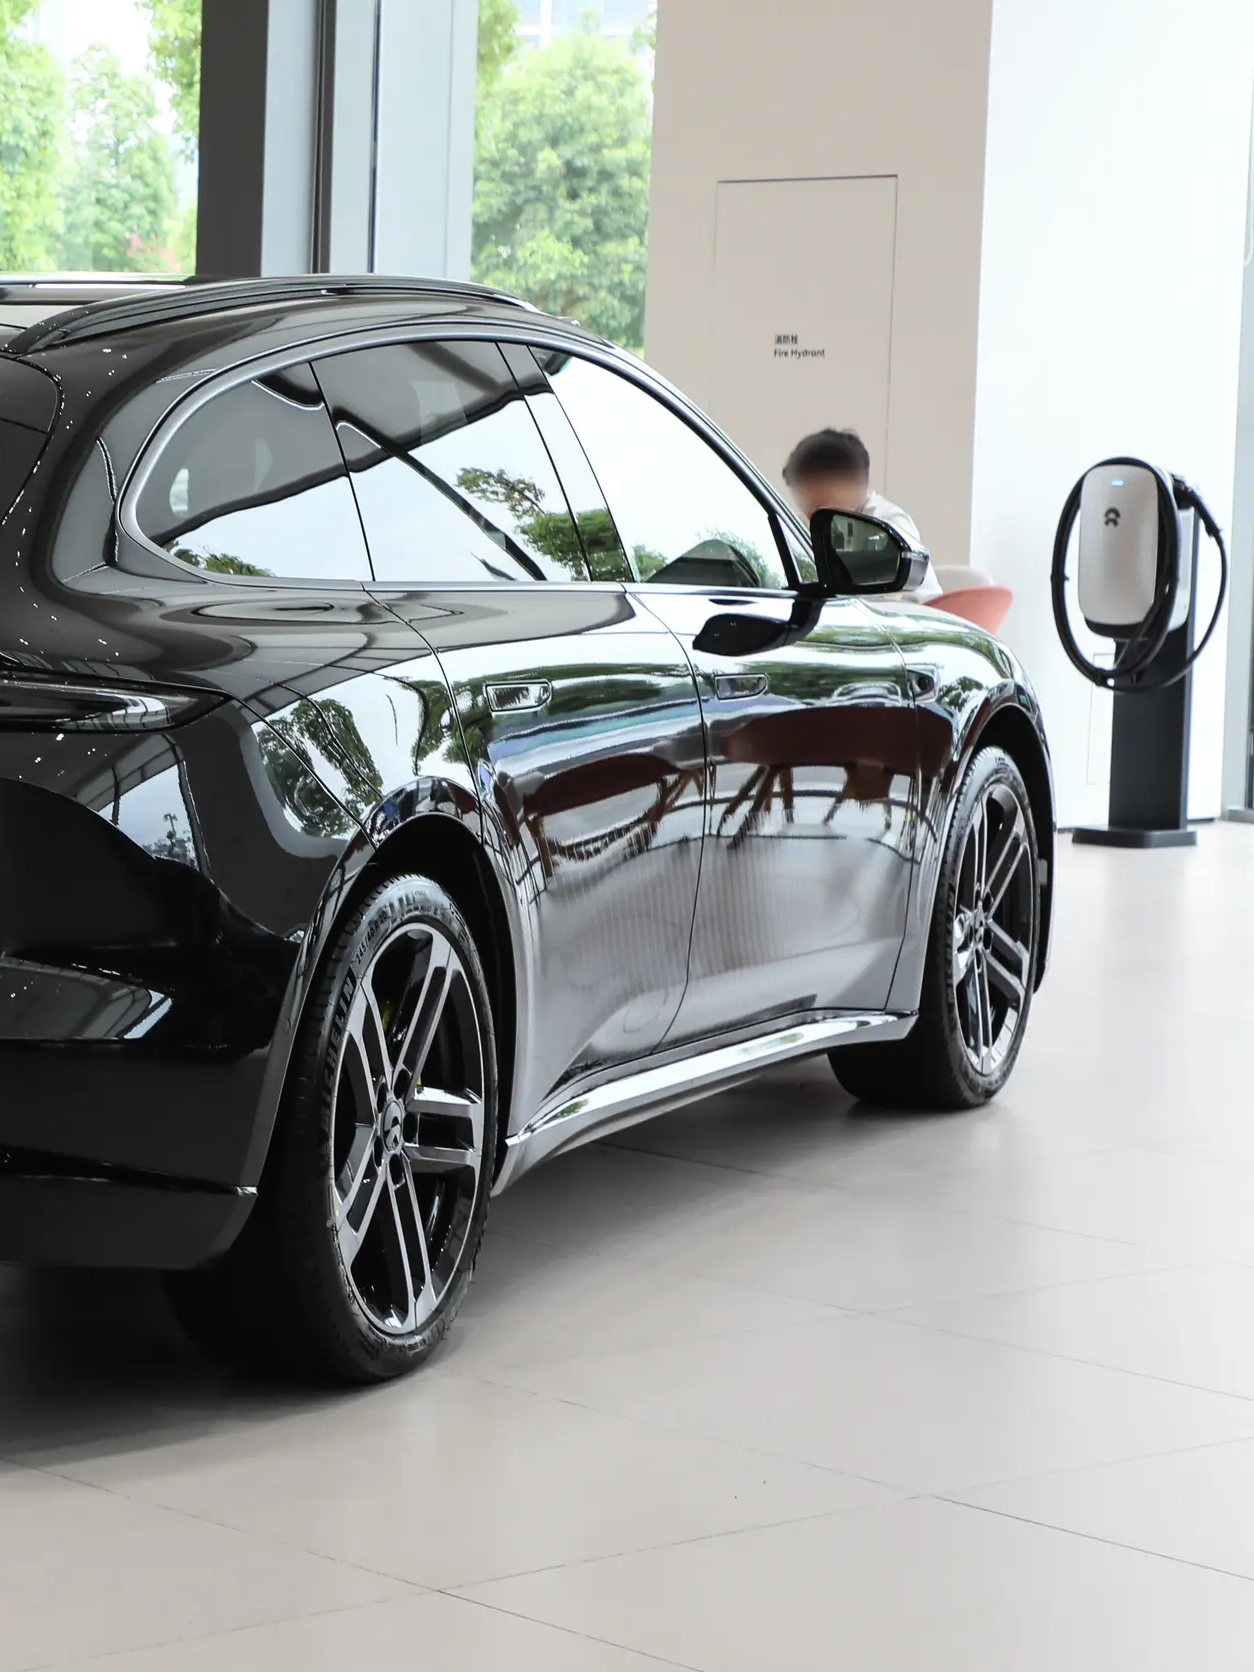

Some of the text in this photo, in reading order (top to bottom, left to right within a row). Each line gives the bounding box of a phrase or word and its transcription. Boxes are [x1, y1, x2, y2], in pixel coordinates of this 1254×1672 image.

[774, 348, 825, 360] Fire Hydrant
[322, 974, 356, 1131] MICHELIN
